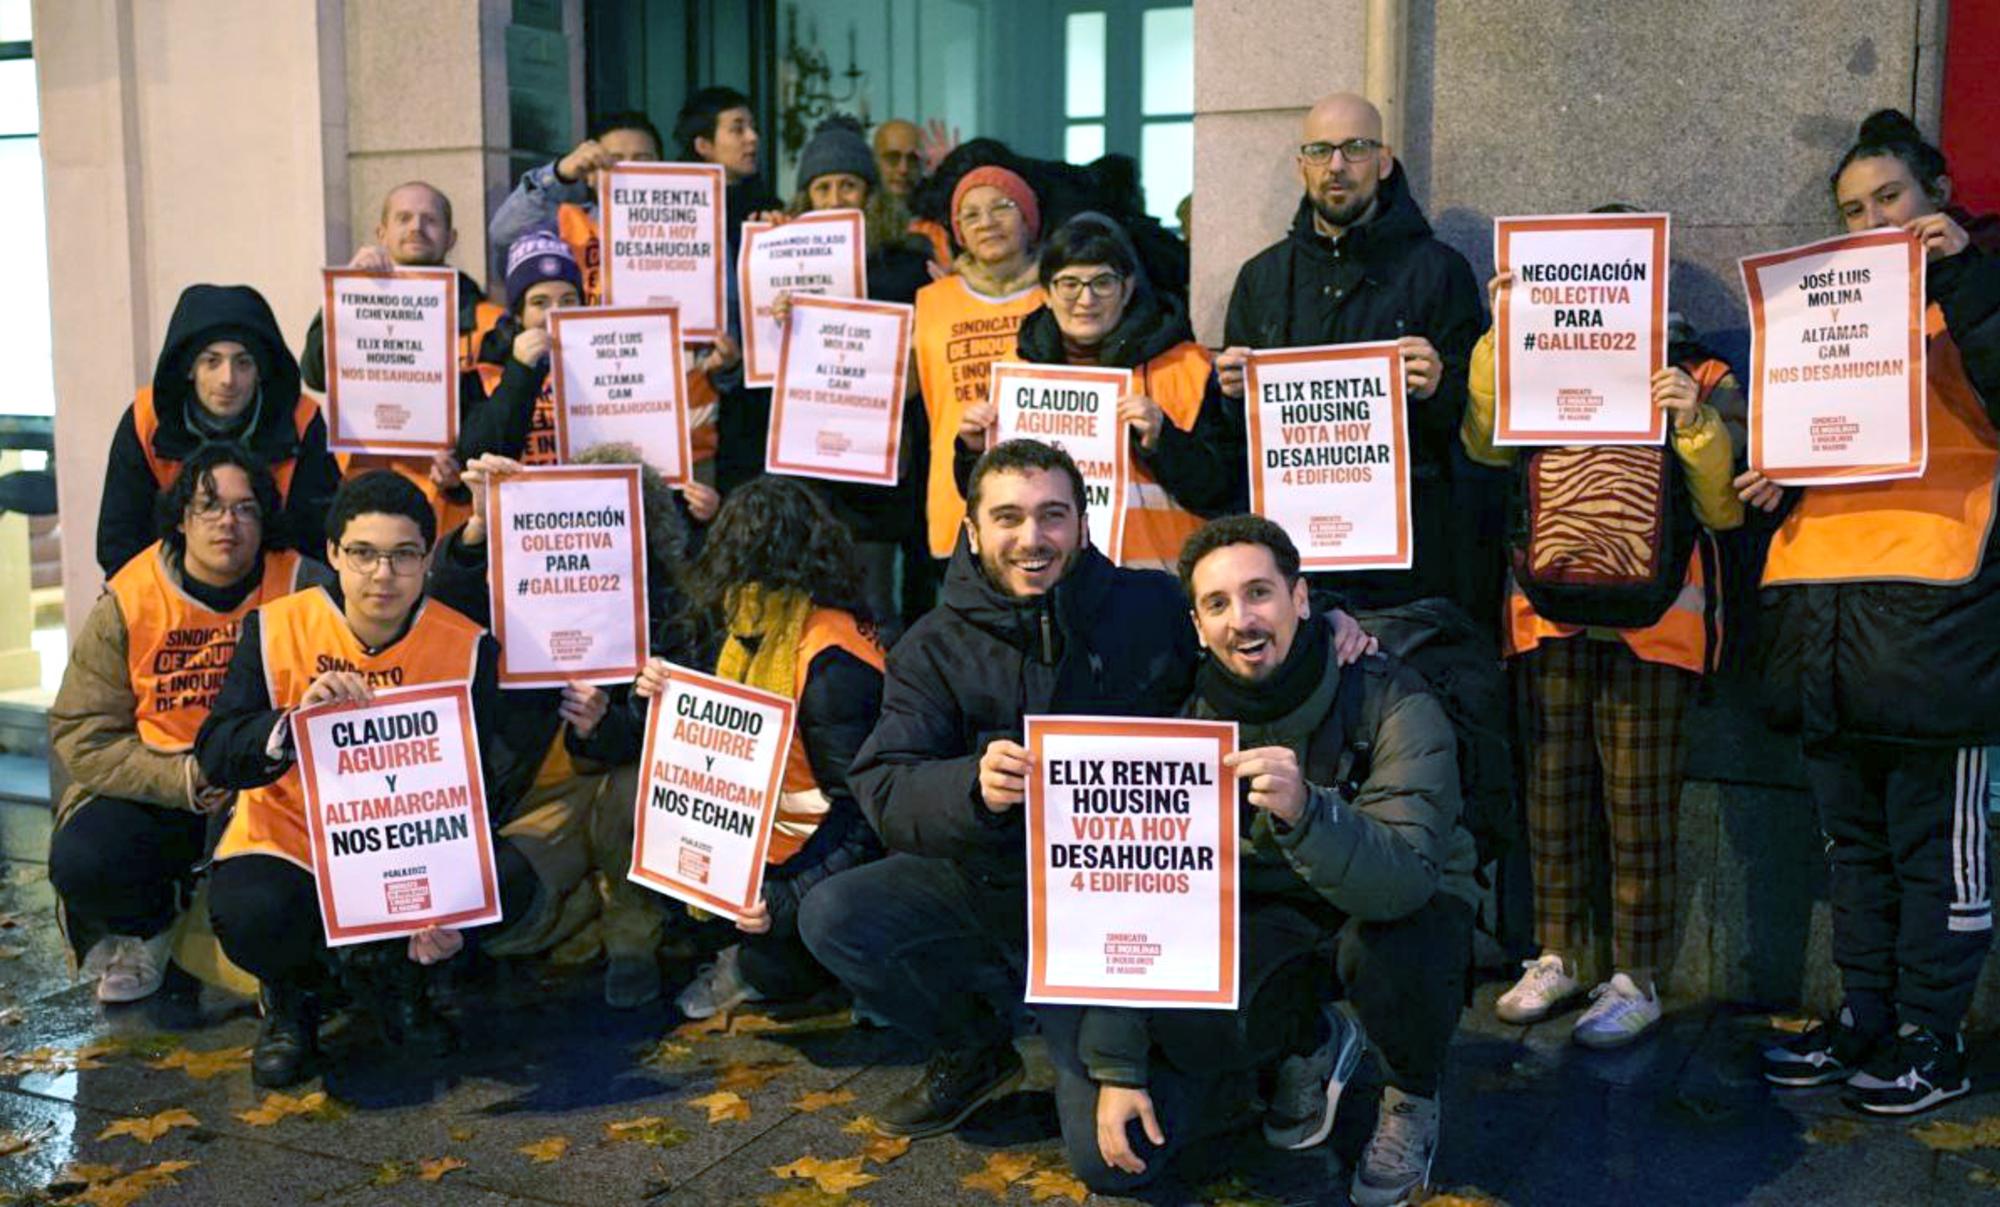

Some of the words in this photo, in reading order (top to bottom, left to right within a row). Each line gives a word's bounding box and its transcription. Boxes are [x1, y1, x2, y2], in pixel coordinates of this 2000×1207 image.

[614, 189, 647, 205] ELIX
[652, 190, 709, 206] RENTAL
[628, 208, 697, 223] HOUSING
[628, 225, 665, 238] VOTA
[669, 225, 698, 239] HOY
[615, 241, 711, 257] DESAHUCIAR
[626, 259, 634, 271] 4
[638, 259, 697, 272] EDIFICIOS
[1522, 259, 1646, 282] NEGOCIACIÓN
[1799, 270, 1835, 290] JOSÉ
[1839, 269, 1870, 285] LUIS
[342, 294, 399, 306] FERNANDO
[1531, 286, 1630, 305] COLECTIVA
[1808, 289, 1862, 308] MOLINA
[1554, 309, 1603, 327] PARA
[1831, 308, 1840, 323] Y
[819, 323, 846, 336] JOSÉ
[849, 325, 871, 339] LUIS
[951, 316, 1019, 338] SINDICAT
[1802, 324, 1869, 343] ALTAMAR
[357, 338, 379, 350] ELIX
[383, 338, 423, 351] RENTAL
[590, 332, 616, 346] JOSÉ
[619, 333, 642, 344] LUIS
[1524, 332, 1637, 350] #GALILEO22
[367, 354, 415, 364] HOUSING
[1819, 344, 1850, 360] CAM
[342, 368, 364, 381] NOS
[368, 369, 442, 382] DESAHUCIAN
[594, 373, 644, 386] ALTAMAR
[817, 364, 866, 378] ALTAMAR
[1769, 367, 1798, 385] NOS
[1802, 359, 1904, 382] DESAHUCIAN
[608, 388, 632, 400] CAM
[1017, 387, 1099, 413] CLAUDIO
[1264, 382, 1305, 403] ELIX
[1311, 378, 1386, 400] RENTAL
[571, 404, 594, 416] NOS
[596, 402, 671, 416] DESAHUCIAN
[1282, 401, 1370, 424] HOUSING
[1015, 411, 1098, 437] AGUIRRE
[1282, 425, 1329, 445] VOTA
[1335, 423, 1371, 442] HOY
[1267, 444, 1390, 468] DESAHUCIAR
[1283, 470, 1292, 486] 4
[1297, 467, 1372, 485] EDIFICIOS
[514, 506, 624, 530] NEGOCIACIÓN
[522, 532, 612, 552] COLECTIVA
[546, 554, 590, 572] PARA
[518, 575, 620, 596] #GALILEO22
[316, 654, 403, 686] SINATO
[677, 693, 763, 735] CLAUDIO
[332, 710, 438, 747] CLAUDIO
[674, 719, 758, 761] AGUIRRE
[338, 737, 442, 775] AGUIRRE
[706, 756, 714, 771] Y
[1050, 760, 1104, 785] ELIX
[1113, 761, 1212, 786] RENTAL
[385, 775, 397, 793] Y
[654, 760, 763, 810] ALTAMARCAM
[326, 785, 468, 826] ALTAMARCAM
[652, 785, 689, 817] NOS
[692, 799, 755, 838] ECHAN
[1073, 789, 1189, 814] HOUSING
[332, 827, 381, 856] NOS
[386, 814, 468, 849] ECHAN
[1072, 817, 1135, 841] VOTA
[1142, 817, 1191, 841] HOY
[1051, 844, 1213, 871] DESAHUCIAR
[1071, 872, 1084, 892] 4
[1090, 873, 1189, 894] EDIFICIOS
